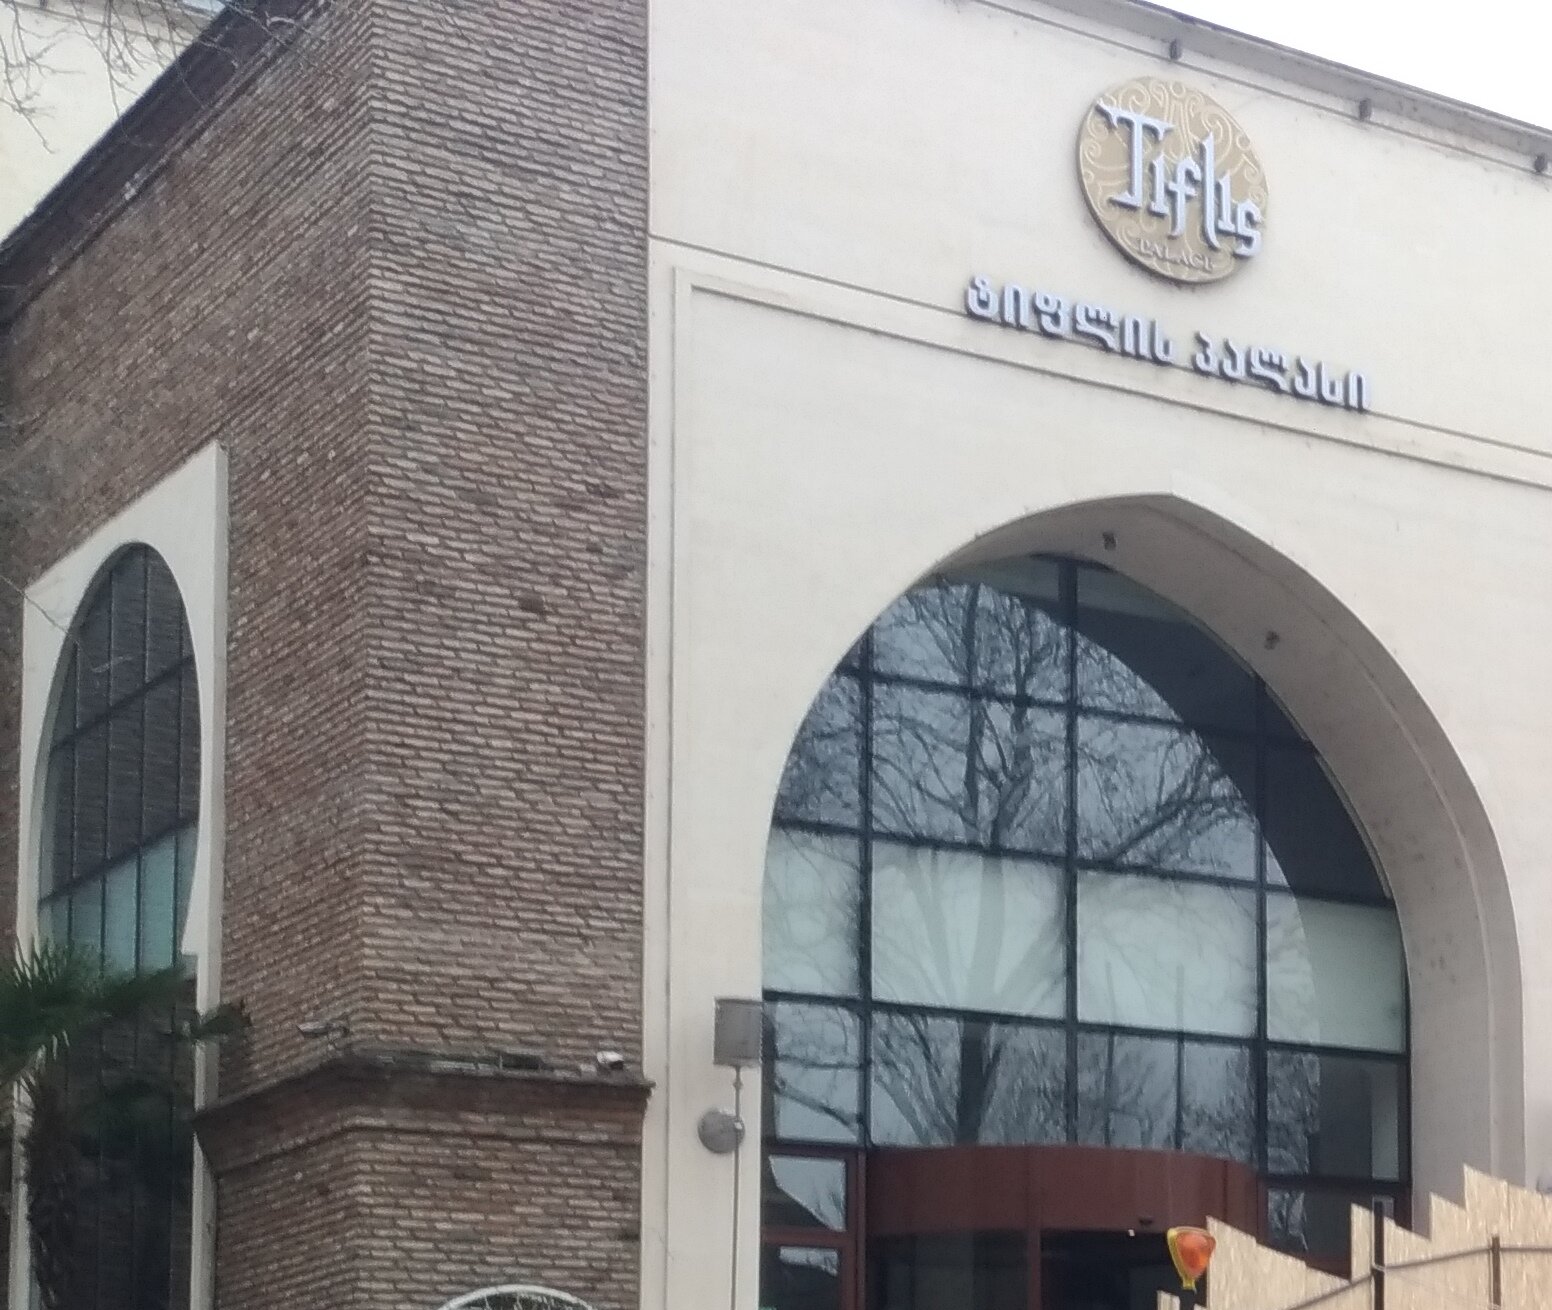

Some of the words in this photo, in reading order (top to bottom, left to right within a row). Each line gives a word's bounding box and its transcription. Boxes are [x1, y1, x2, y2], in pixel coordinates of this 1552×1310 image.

[1095, 97, 1263, 258] Tiflis
[1138, 238, 1214, 273] PALACE
[966, 274, 1175, 364] ტიფლის
[1193, 330, 1371, 412] პალასი
